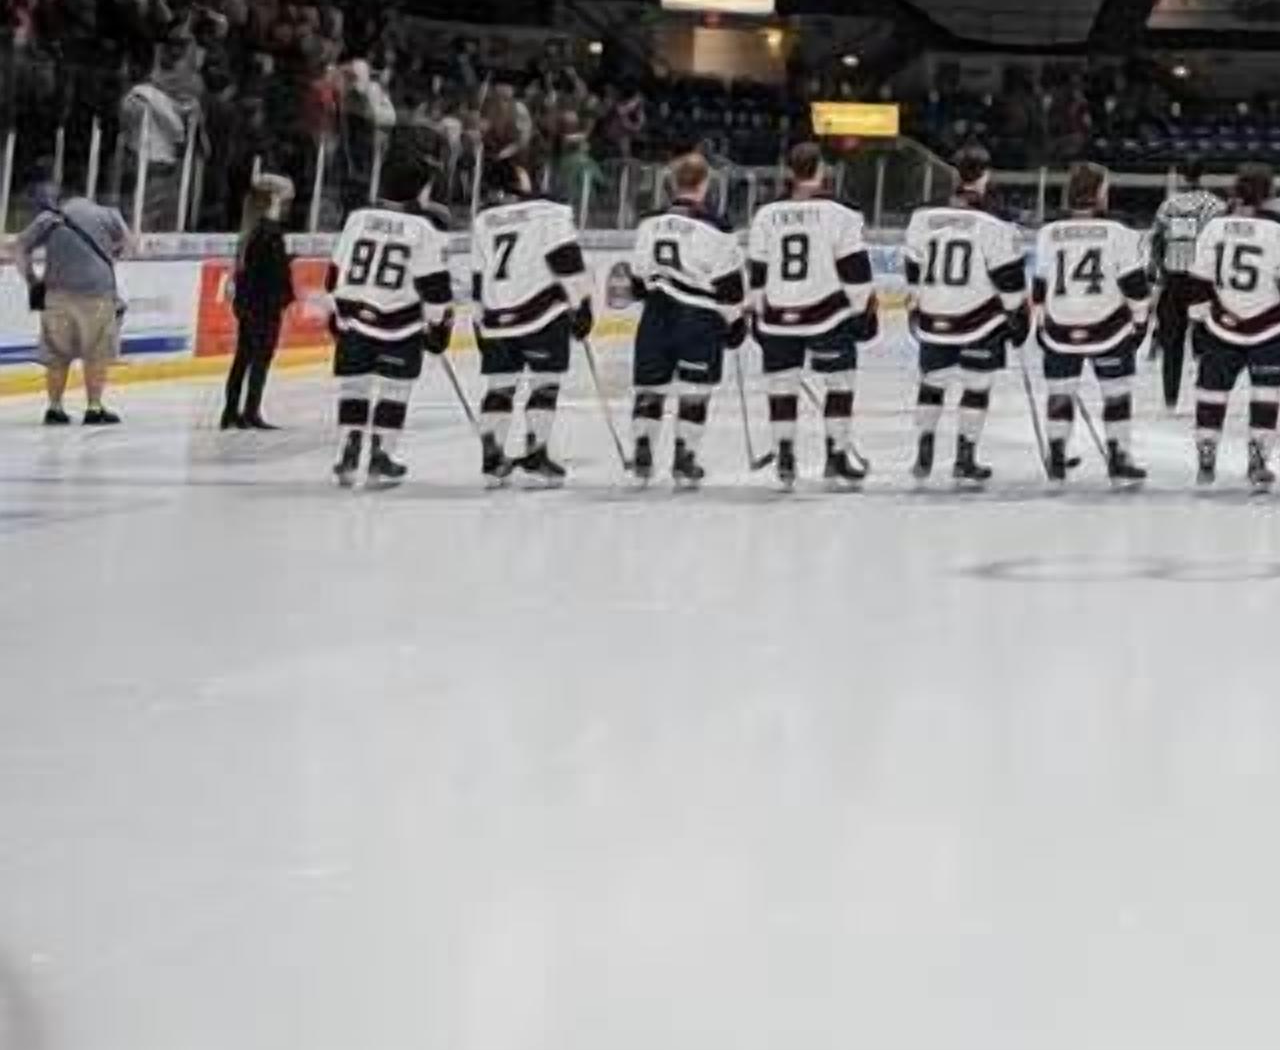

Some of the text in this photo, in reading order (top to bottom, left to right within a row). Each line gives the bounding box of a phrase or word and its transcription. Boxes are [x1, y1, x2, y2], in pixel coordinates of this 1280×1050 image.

[494, 232, 518, 280] 7
[781, 233, 809, 281] 8
[924, 239, 972, 286] 10
[1053, 248, 1104, 295] 14
[1213, 241, 1265, 291] 15
